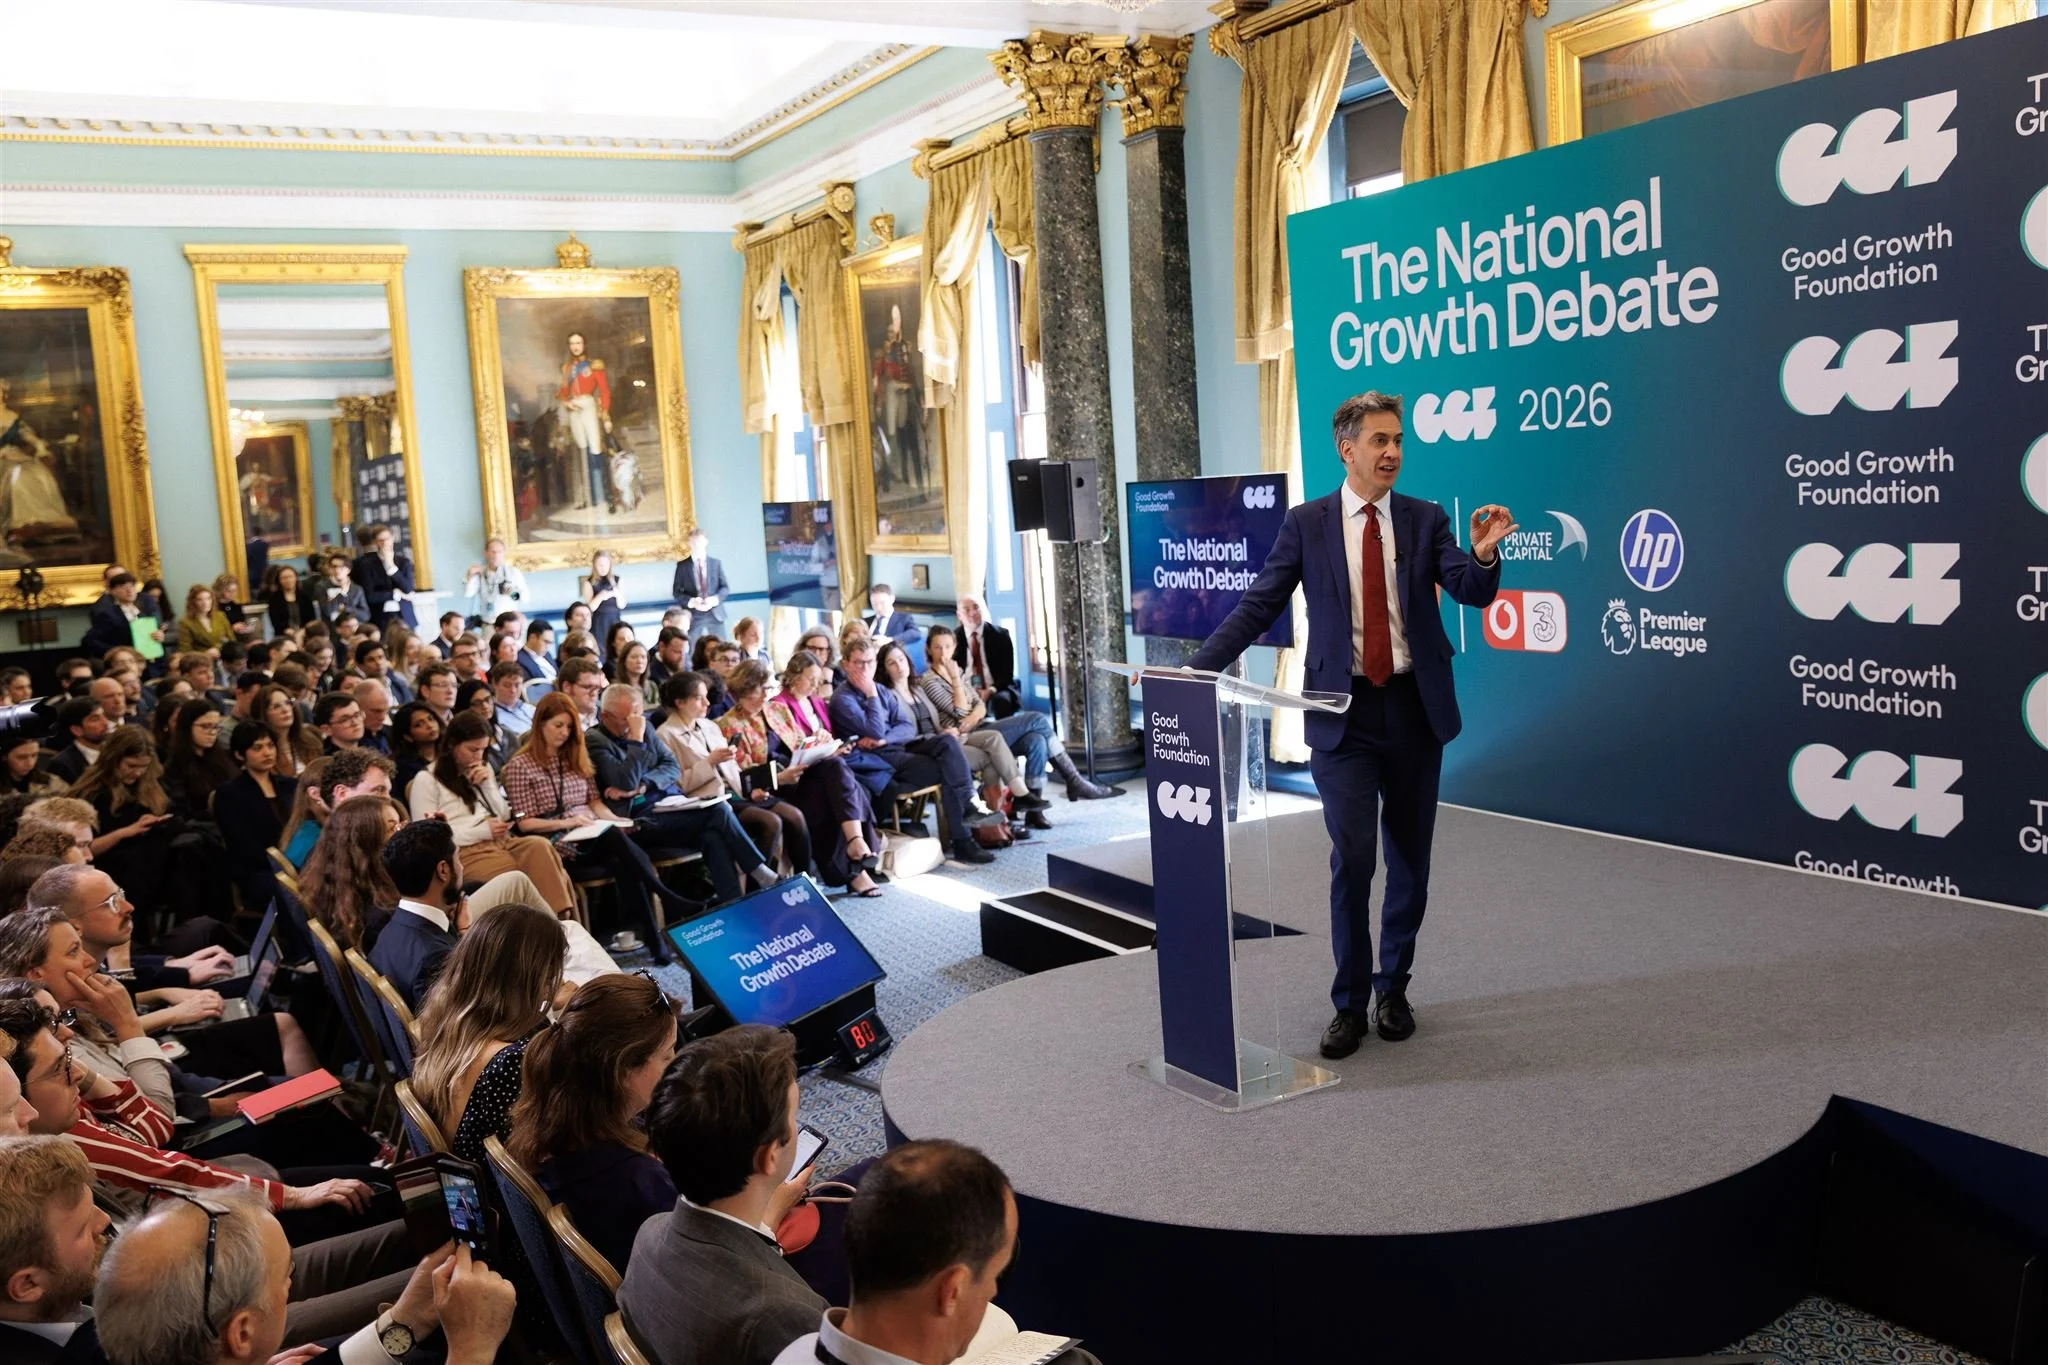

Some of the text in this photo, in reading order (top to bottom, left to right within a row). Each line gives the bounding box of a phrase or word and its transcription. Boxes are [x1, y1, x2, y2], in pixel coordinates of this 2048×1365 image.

[1341, 176, 1662, 303] The National
[1781, 222, 1953, 273] Good Growth
[1794, 260, 1938, 300] Foundation
[1330, 260, 1719, 371] Growth Debate
[1518, 381, 1612, 432] 2026
[1785, 447, 1954, 478] Good Growth
[1135, 489, 1175, 501] Good Growth
[1798, 479, 1939, 505] Foundation
[1135, 502, 1169, 512] Foundation
[1158, 537, 1248, 562] The National
[1504, 532, 1553, 547] PRIVATE
[1504, 546, 1553, 561] CAPITAL
[1629, 511, 1676, 591] hp
[1154, 566, 1206, 590] Growth
[1533, 601, 1557, 642] 3
[1640, 608, 1706, 631] Premier
[1641, 630, 1707, 657] League
[1789, 654, 1957, 690] Good Growth
[1802, 683, 1943, 719] Foundation
[1152, 712, 1178, 728] Good
[1153, 728, 1189, 746] Growth
[1154, 745, 1209, 766] Foundation
[1794, 850, 1960, 897] Good Growth
[681, 918, 725, 940] Good Growth
[688, 929, 725, 948] Foundation
[729, 924, 815, 971] The National
[739, 940, 837, 994] Growth Debate
[850, 1020, 876, 1049] 80
